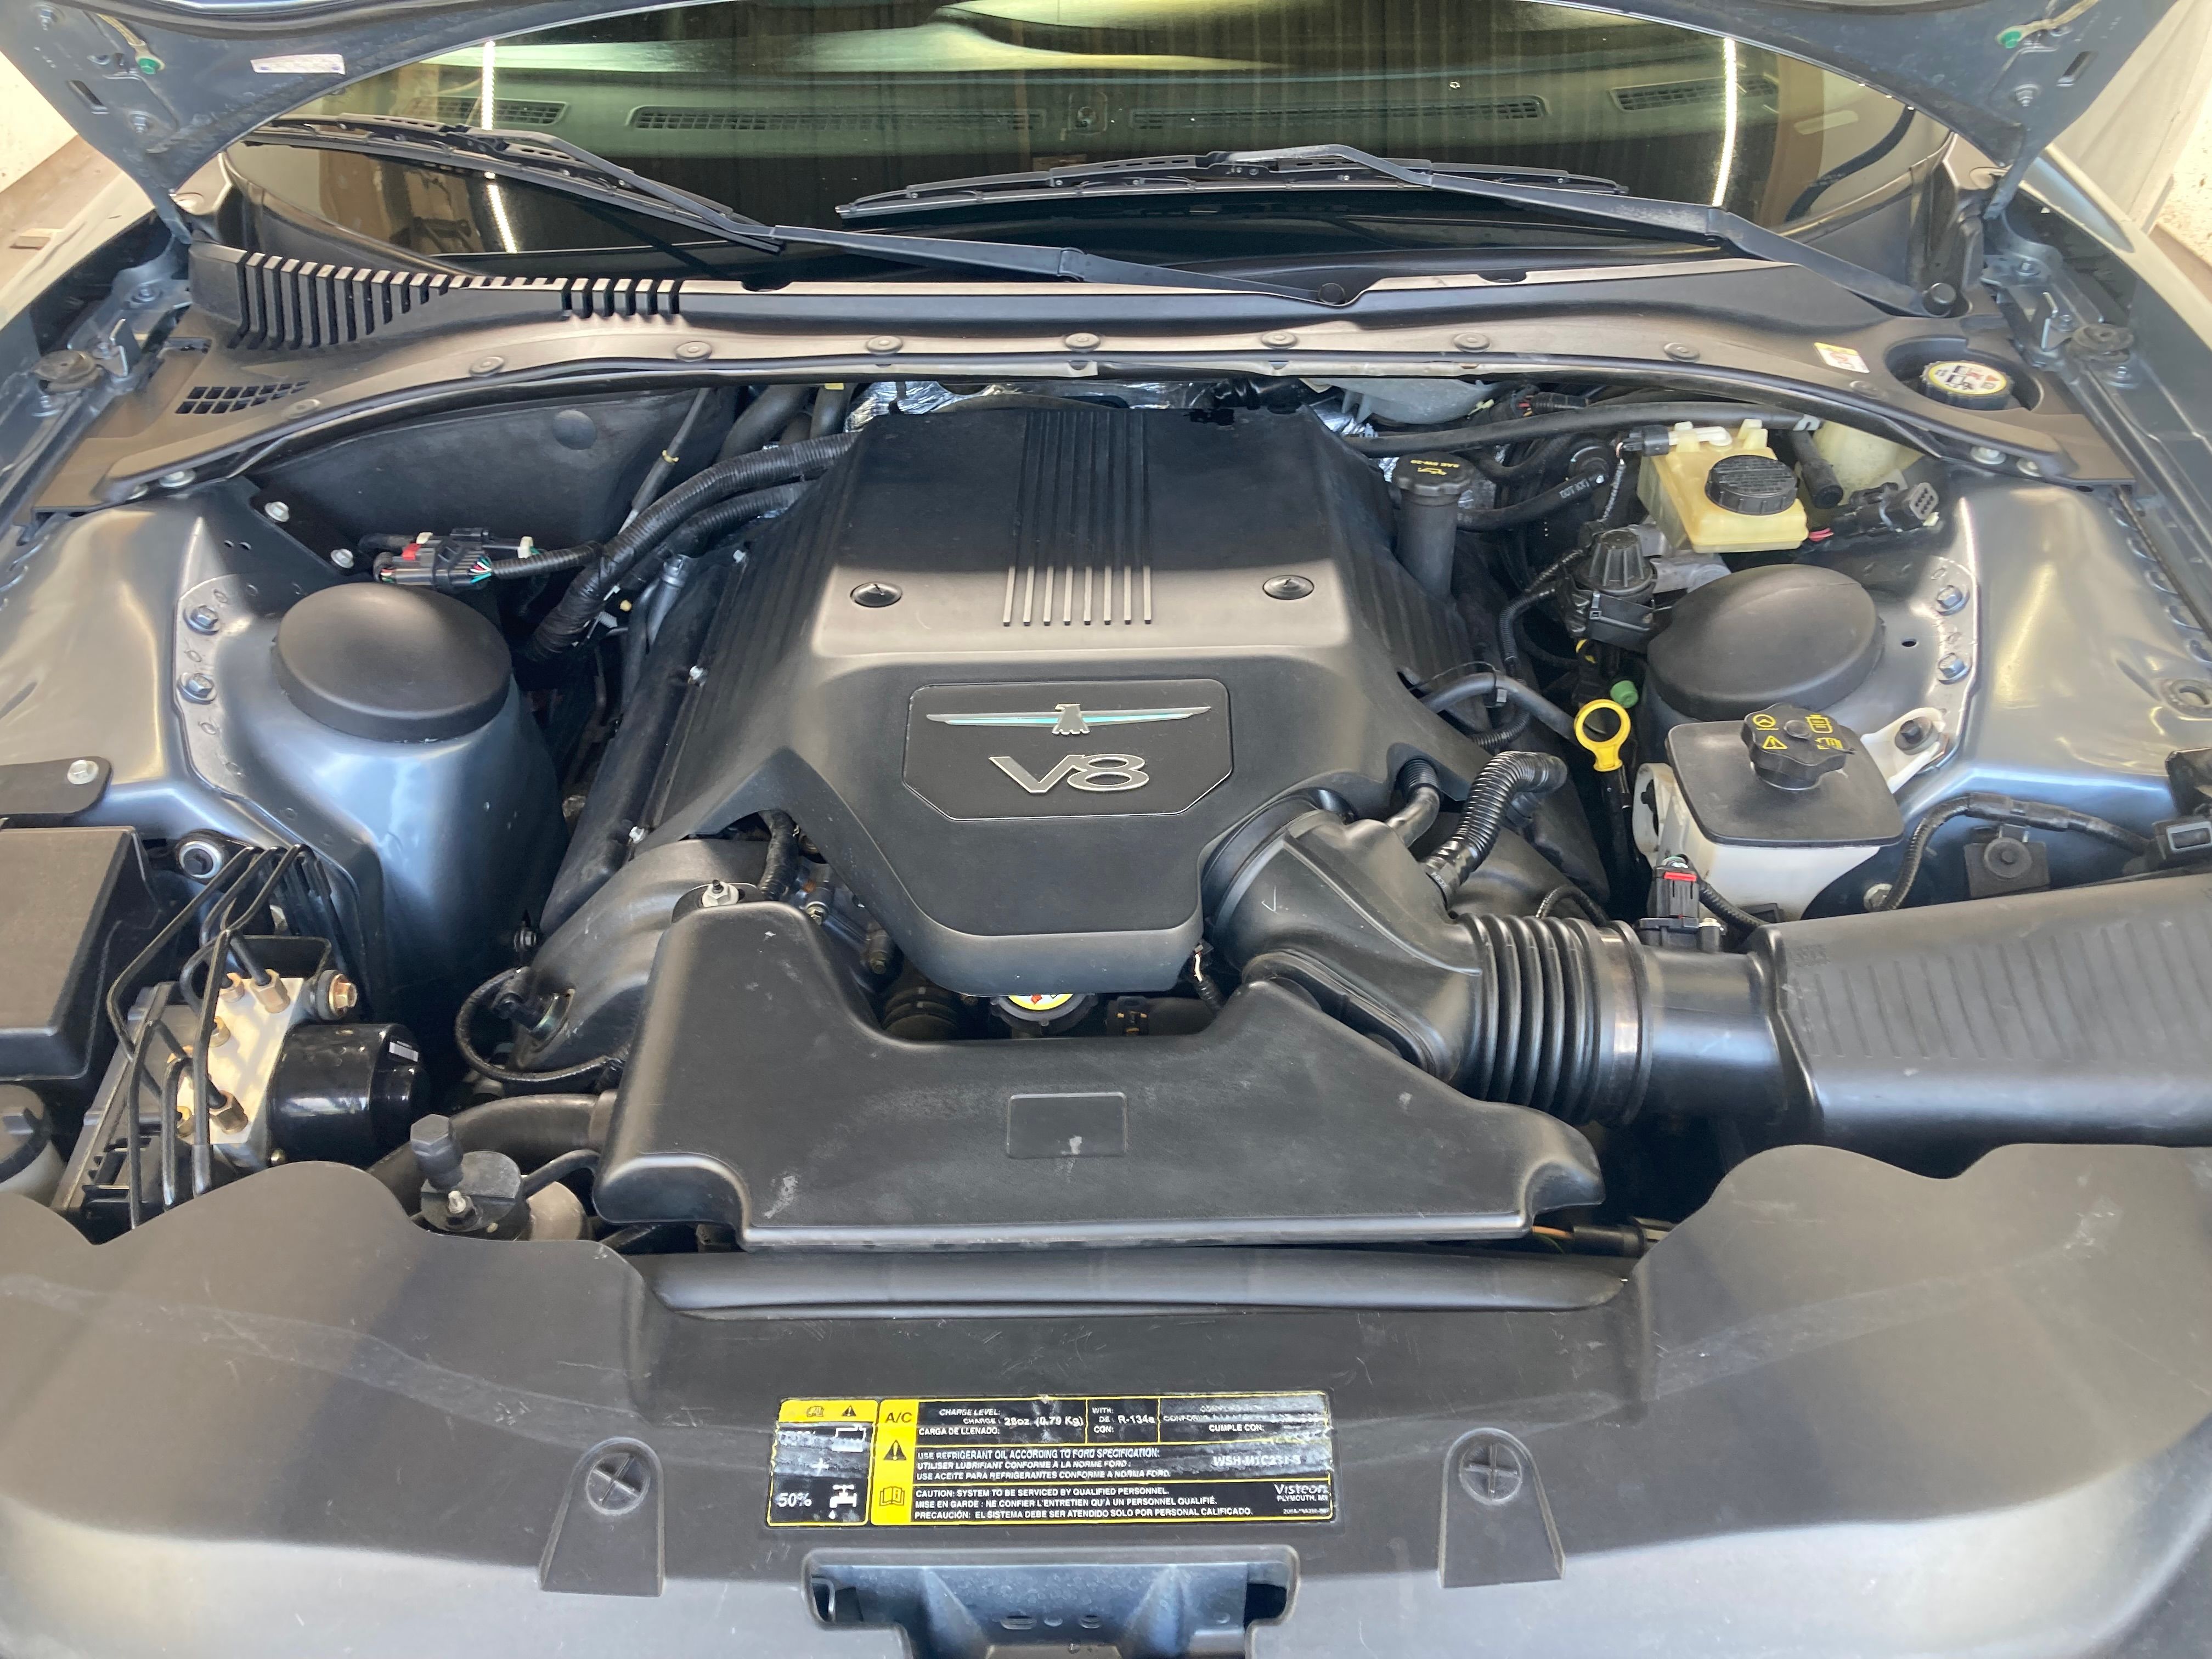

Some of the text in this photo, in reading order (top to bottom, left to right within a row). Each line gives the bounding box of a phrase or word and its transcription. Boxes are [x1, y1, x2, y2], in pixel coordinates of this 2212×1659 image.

[989, 753, 1150, 794] V8
[885, 1412, 912, 1423] A/C
[939, 1407, 1000, 1417] CHARGE LEVEL:
[1004, 1415, 1084, 1427] 28oz (0.79 Kg)
[1118, 1415, 1156, 1424] R-134a
[918, 1427, 947, 1436] CARGA
[961, 1426, 1000, 1435] LLENADO:
[1209, 1423, 1264, 1433] CUMPLE CON:
[936, 1451, 992, 1460] REFRIGERANT
[995, 1451, 1007, 1459] OIL
[1009, 1449, 1057, 1459] ACCORDING
[1060, 1449, 1071, 1459] TO
[1073, 1449, 1094, 1459] FORD
[1097, 1448, 1160, 1458] SPECIFICATION:
[917, 1461, 953, 1470] UTILISER
[955, 1461, 1003, 1469] LUBRIFIANT
[1005, 1460, 1051, 1469] CONFORME
[1060, 1460, 1071, 1469] LA
[1073, 1460, 1102, 1469] NORME
[1104, 1460, 1126, 1468] FORD
[917, 1471, 932, 1481] USE
[935, 1471, 963, 1481] ACEITE
[966, 1471, 987, 1480] PARA
[990, 1470, 1057, 1480] REFRIGERANTES
[1059, 1469, 1104, 1479] CONFORME
[1114, 1469, 1144, 1479] NORMA
[1146, 1469, 1170, 1479] FORD.
[916, 1487, 1169, 1498] CAUTION: SYSTEM TO BE SERVICED BY QUALIFIED PERSONNEL.
[1274, 1483, 1328, 1494] Visteon
[777, 1492, 812, 1508] 50%
[915, 1500, 934, 1509] MISE
[950, 1500, 978, 1508] GARDE
[998, 1499, 1035, 1508] CONFIER
[1037, 1498, 1088, 1507] L'ENTRETIEN
[1091, 1498, 1110, 1506] QU'À
[1126, 1497, 1176, 1506] PERSONNEL
[1177, 1497, 1217, 1505] QUALIFIÉ.
[1277, 1494, 1317, 1502] PLYMOUTH,
[915, 1506, 1253, 1519] PRECAUCIÓN: EL SISTEMA DEBE SER ATENDIDO SOLO POR PERSONAL CALIFICADO.
